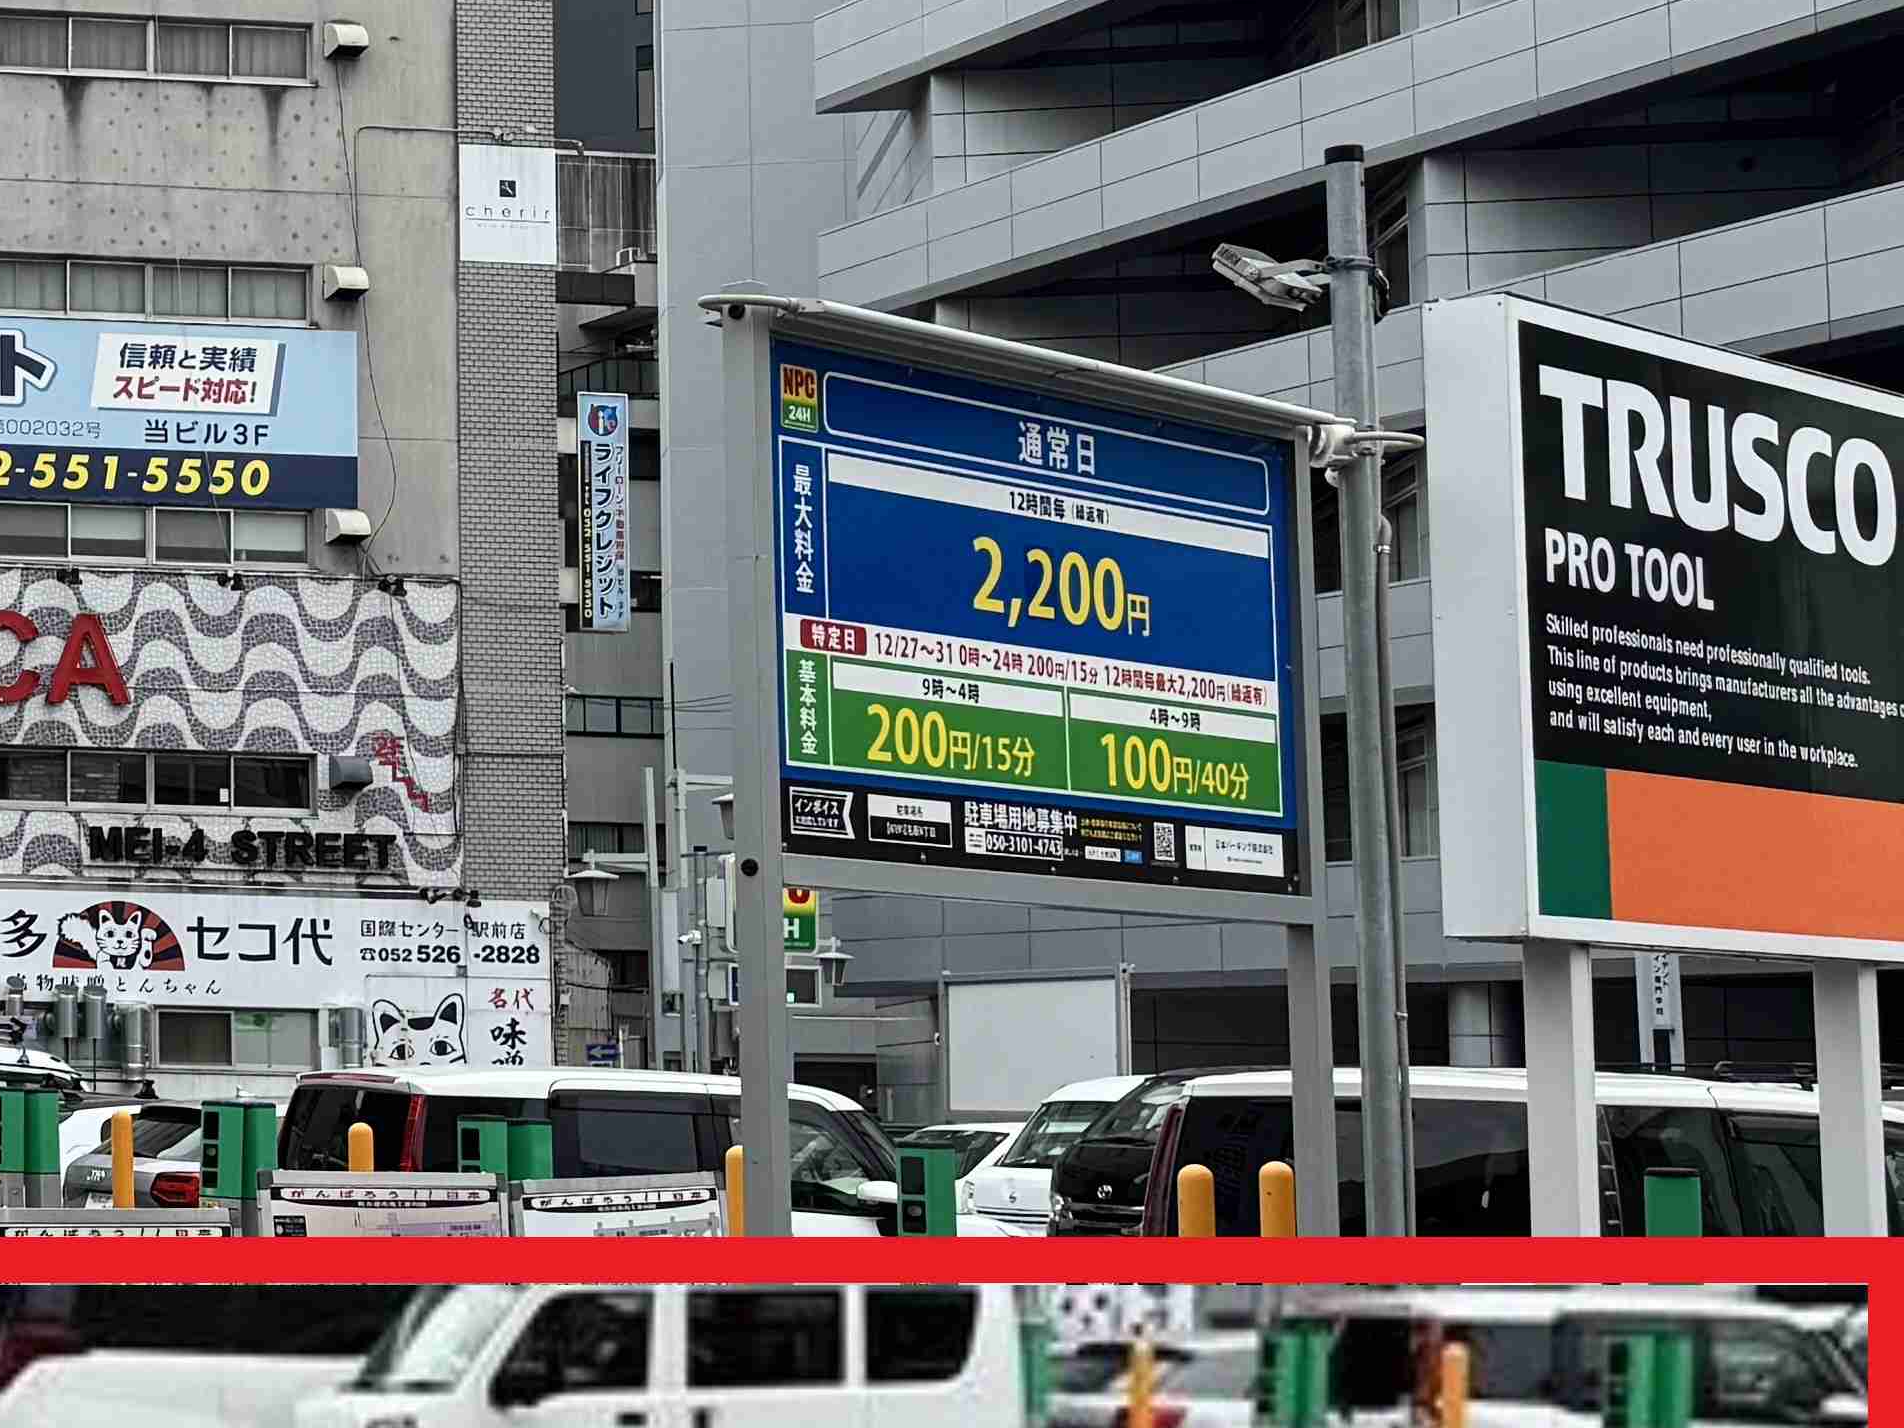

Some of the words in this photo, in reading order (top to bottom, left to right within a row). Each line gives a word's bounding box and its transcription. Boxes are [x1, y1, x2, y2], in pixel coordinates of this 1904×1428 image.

[119, 342, 257, 373] 信頼と実績
[783, 368, 815, 399] NPC
[143, 419, 270, 446] 当ビル3F
[788, 405, 811, 423] 24H
[1018, 421, 1096, 476] 通常日
[1539, 365, 1897, 567] TRUSCO
[594, 443, 615, 619] ライフクレジット
[793, 464, 815, 594] 最大料金
[973, 536, 1152, 638] 2,200円
[1545, 528, 1617, 594] PRO
[1624, 542, 1715, 613] TOOL
[811, 622, 856, 652] 特定日
[1028, 654, 1098, 685] 200円/15分
[1546, 613, 1588, 640] Skilled
[1591, 623, 1673, 654] professionals
[1675, 639, 1704, 659] need
[1706, 643, 1787, 675] professionally
[1789, 656, 1838, 682] qualified
[1840, 664, 1871, 685] tools.
[798, 659, 818, 755] 基本料金
[1547, 645, 1575, 669] This
[1576, 650, 1600, 672] line
[1603, 655, 1617, 673] of
[1620, 658, 1674, 684] products
[1676, 666, 1713, 691] brings
[1715, 674, 1798, 703] manufacturers
[1799, 685, 1814, 704] all
[1815, 688, 1835, 708] the
[1836, 690, 1898, 720] advantages
[1548, 678, 1583, 704] using
[1586, 683, 1642, 709] excellent
[1644, 693, 1713, 722] equipment,
[867, 703, 1036, 778] 200円/15分
[1100, 733, 1249, 800] 100円/40分
[1550, 709, 1573, 729] and
[1578, 712, 1601, 733] will
[1603, 717, 1644, 743] satisfy
[1647, 722, 1675, 743] each
[1678, 727, 1700, 747] and
[1701, 733, 1734, 755] every
[1736, 736, 1761, 755] user
[1763, 738, 1775, 757] in
[1778, 739, 1797, 761] the
[1799, 742, 1859, 769] workplace.
[232, 829, 397, 869] STREET
[964, 801, 1078, 836] 駐車場用地募集中
[986, 832, 1063, 858] 050-3101-4743
[187, 916, 333, 966] セコ代
